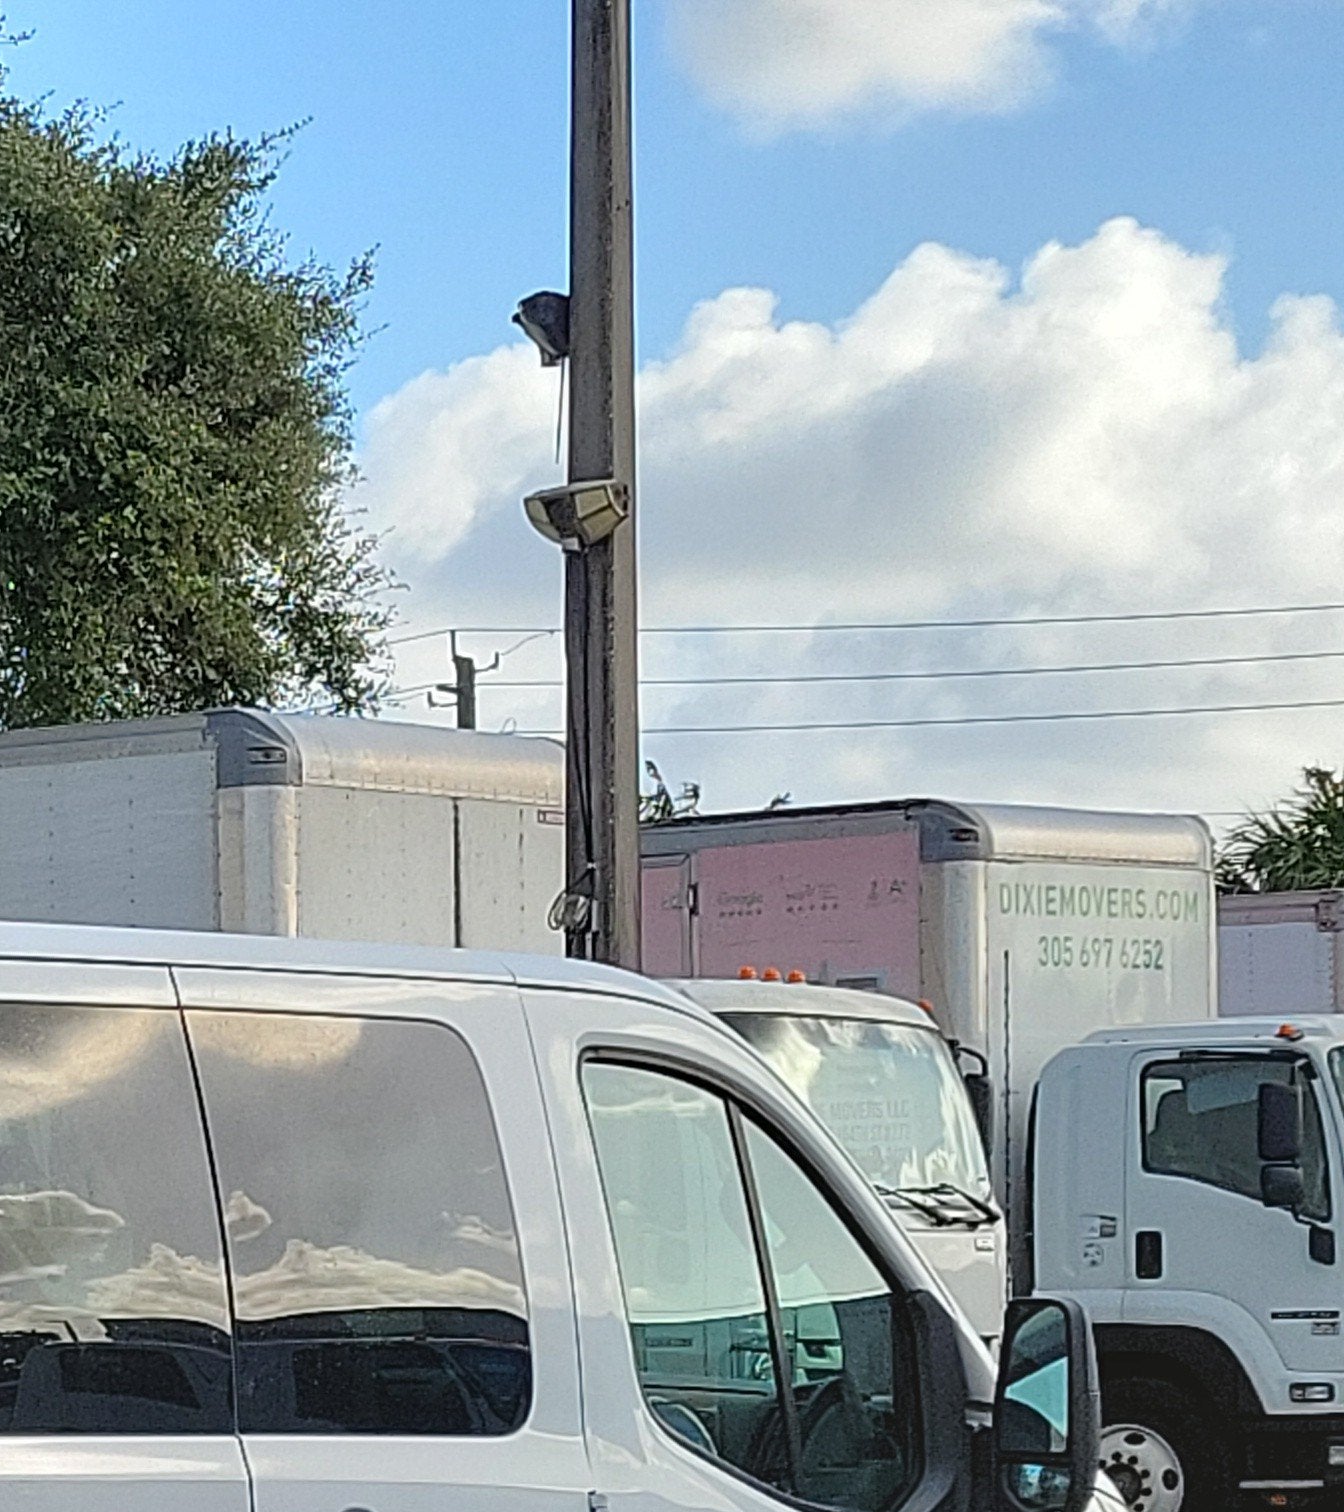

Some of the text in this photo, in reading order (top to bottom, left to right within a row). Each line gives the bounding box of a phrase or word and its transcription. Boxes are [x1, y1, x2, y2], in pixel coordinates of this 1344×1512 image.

[999, 882, 1200, 922] DIXIEMOVERS.COM
[1037, 936, 1164, 971] 305 697 6252
